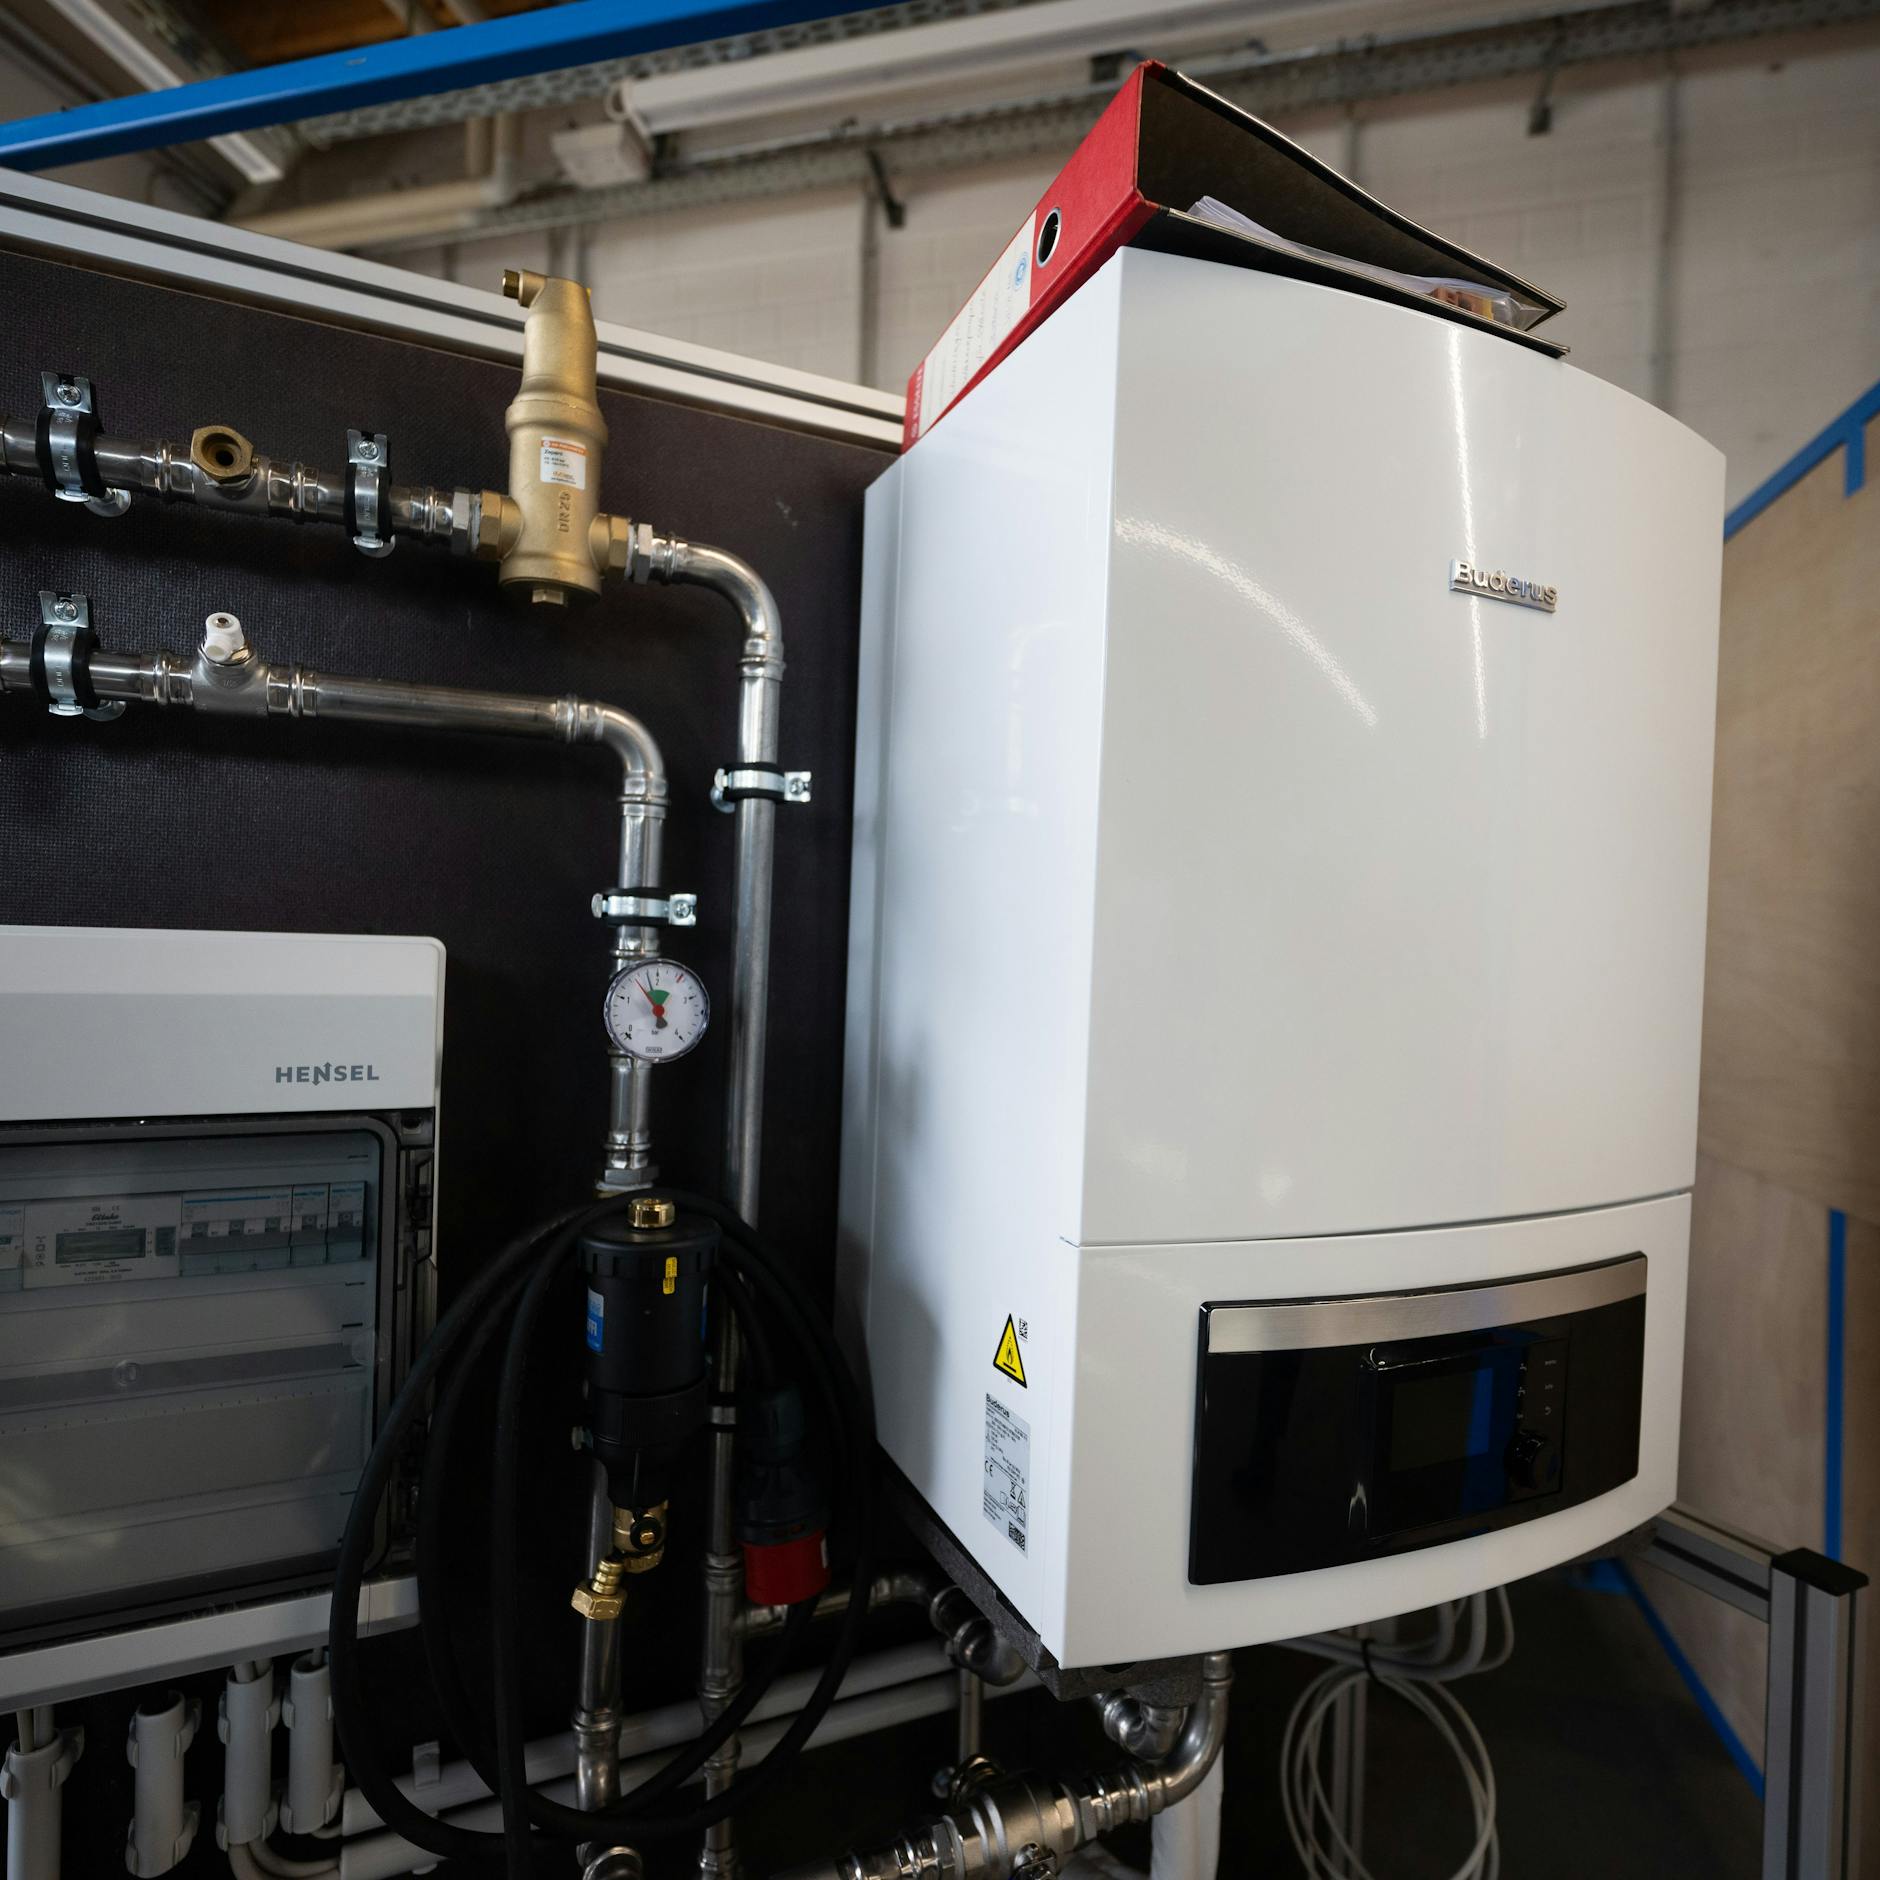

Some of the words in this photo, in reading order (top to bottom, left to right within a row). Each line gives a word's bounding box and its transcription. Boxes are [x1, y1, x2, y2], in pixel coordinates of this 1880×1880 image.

[1454, 559, 1558, 606] Buderus
[275, 1062, 379, 1085] HENSEL
[986, 1393, 1010, 1418] Buderus
